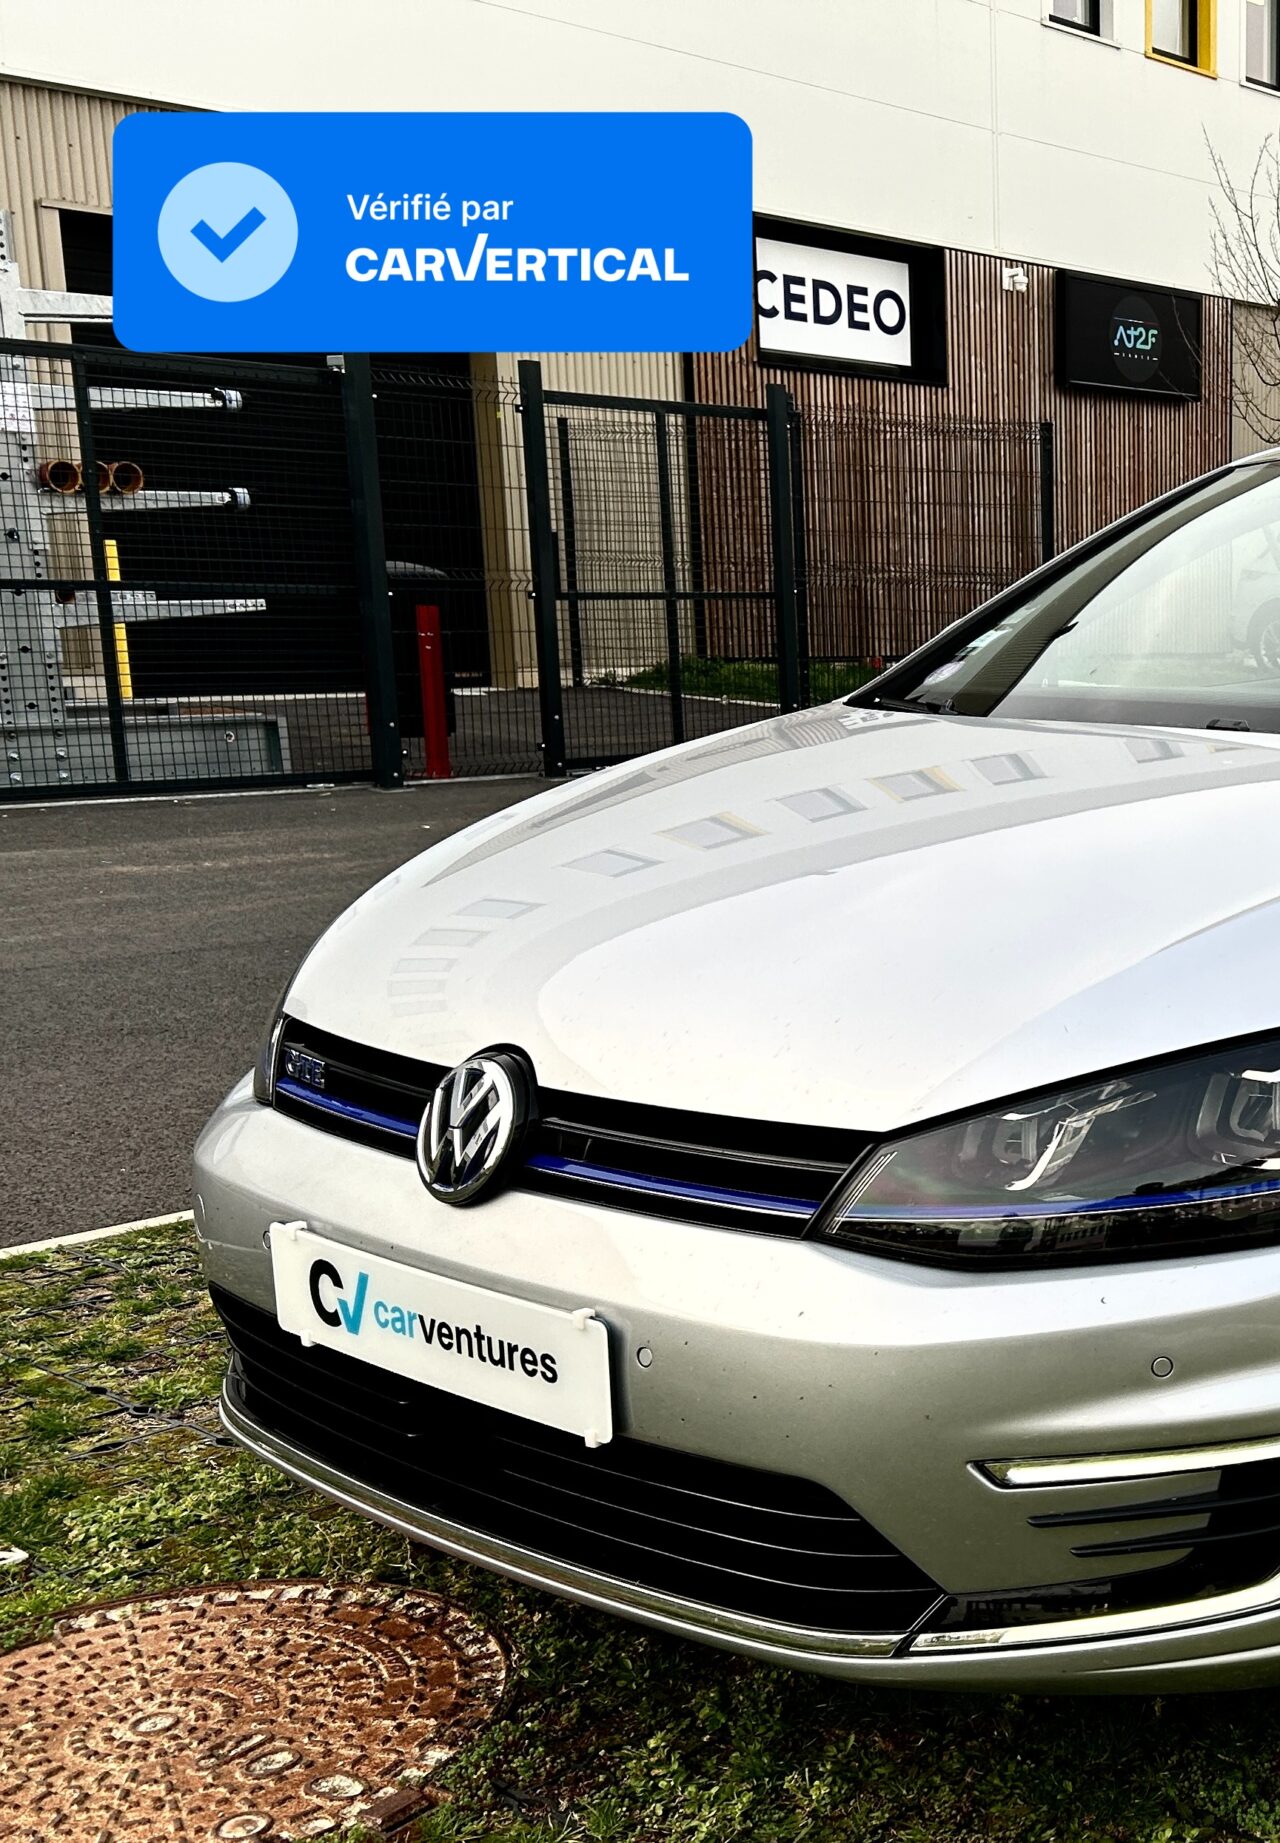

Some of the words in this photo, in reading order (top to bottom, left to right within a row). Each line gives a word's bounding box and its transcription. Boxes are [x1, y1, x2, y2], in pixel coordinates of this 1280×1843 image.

[756, 269, 907, 336] CEDEO
[285, 1048, 326, 1089] GTE
[373, 1299, 560, 1385] carventures
